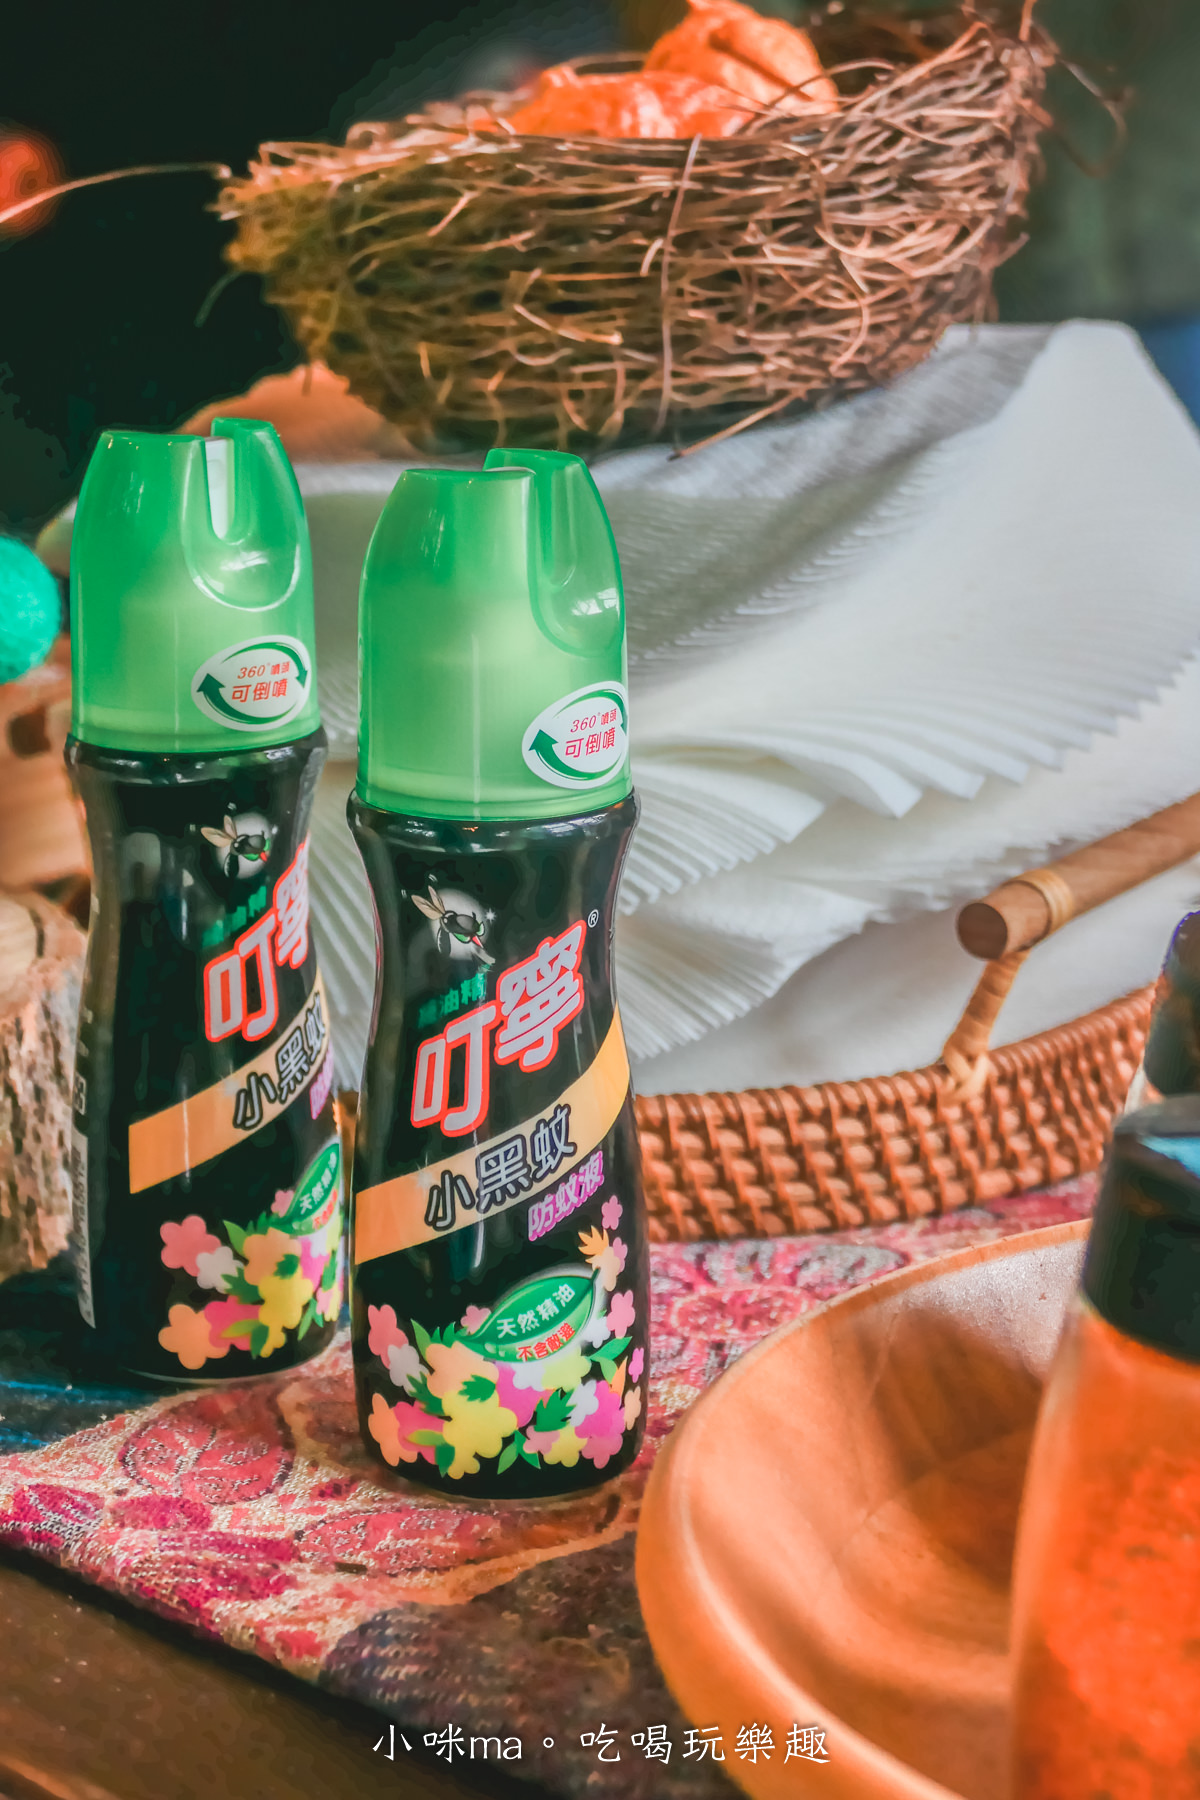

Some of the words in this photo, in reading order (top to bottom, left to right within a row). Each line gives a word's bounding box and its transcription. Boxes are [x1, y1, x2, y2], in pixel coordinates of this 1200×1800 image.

[232, 678, 288, 703] 可倒噴
[564, 727, 616, 758] 可倒噴
[424, 1104, 577, 1231] 小黑蚊
[528, 1151, 604, 1241] 防蚊液
[496, 1283, 576, 1339] 天然精油
